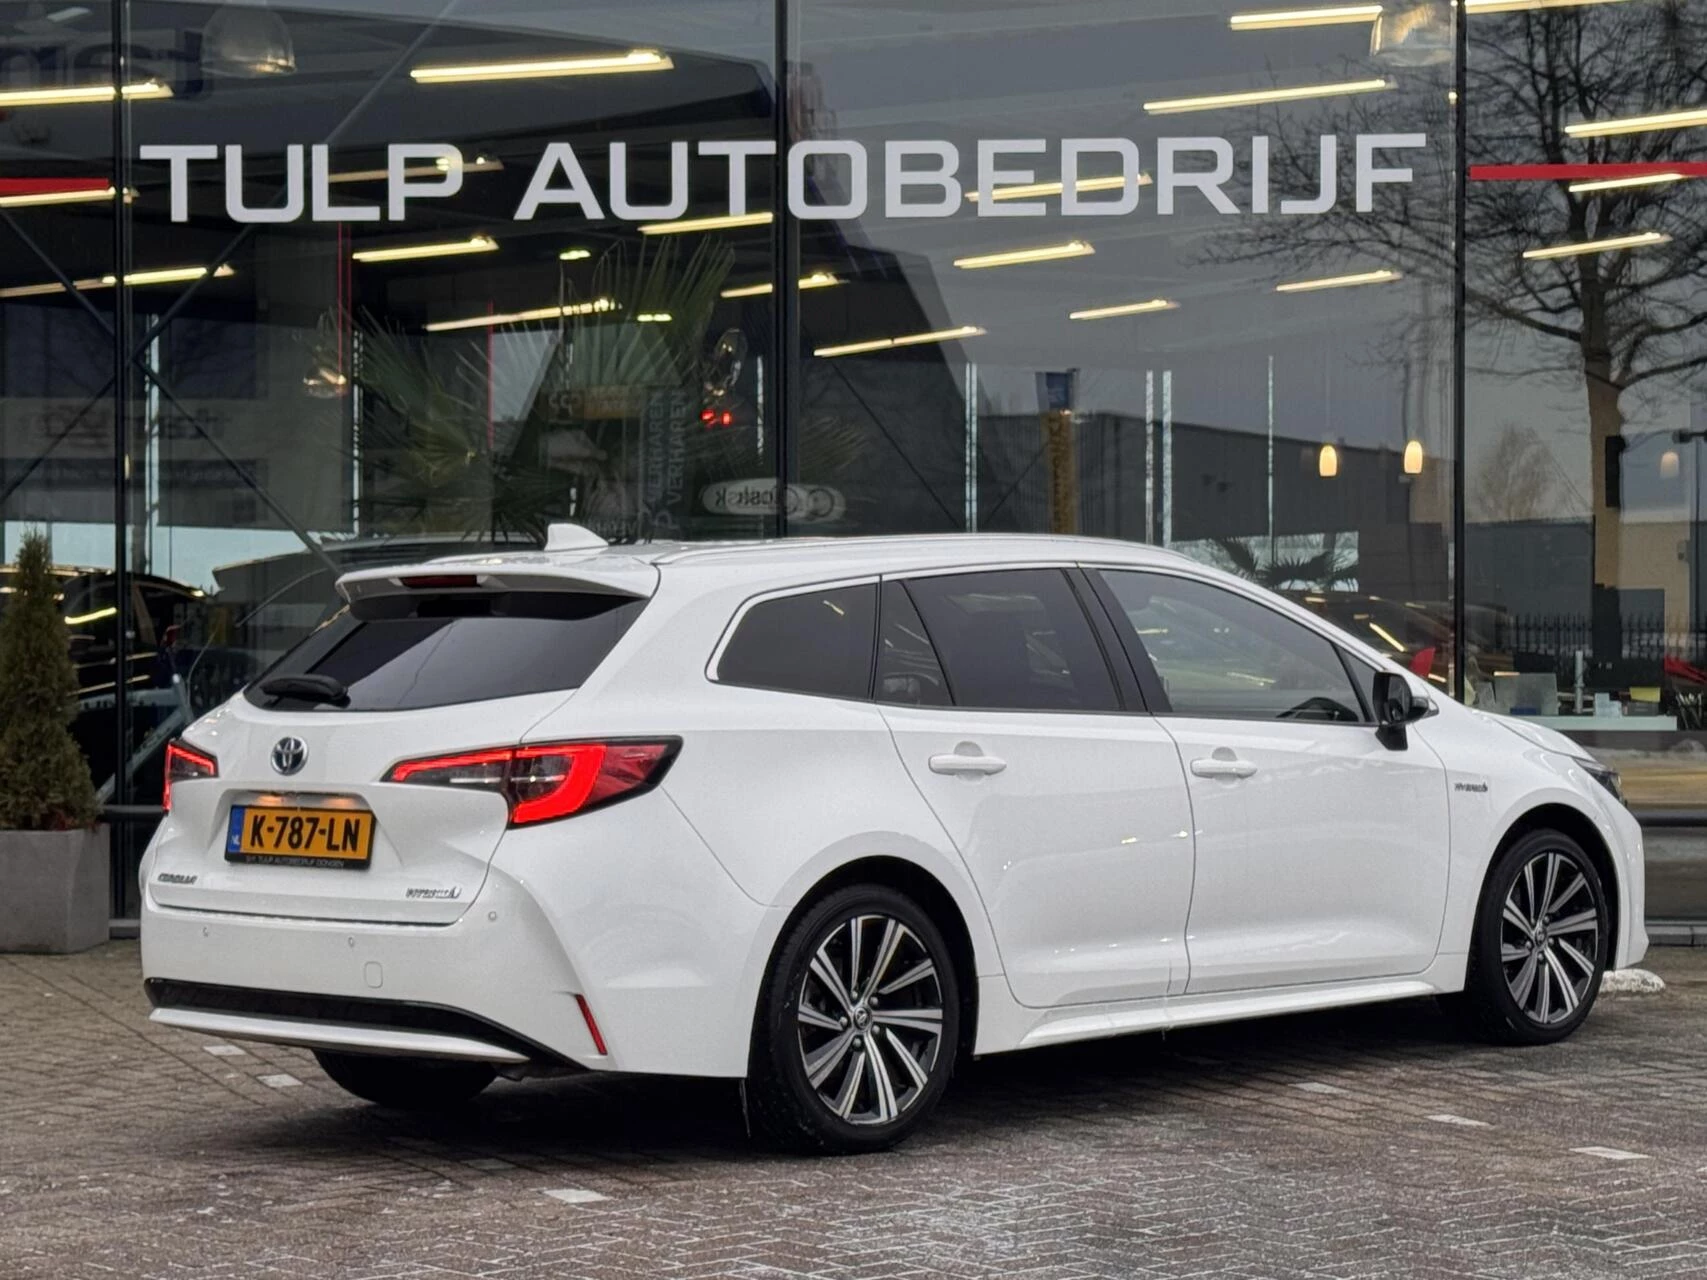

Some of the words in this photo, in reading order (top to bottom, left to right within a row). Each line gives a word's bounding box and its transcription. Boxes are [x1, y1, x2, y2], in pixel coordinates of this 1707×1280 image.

[139, 143, 463, 223] TULP
[513, 133, 1427, 221] AUTOBEDRIJF
[250, 814, 361, 853] K-787-LN
